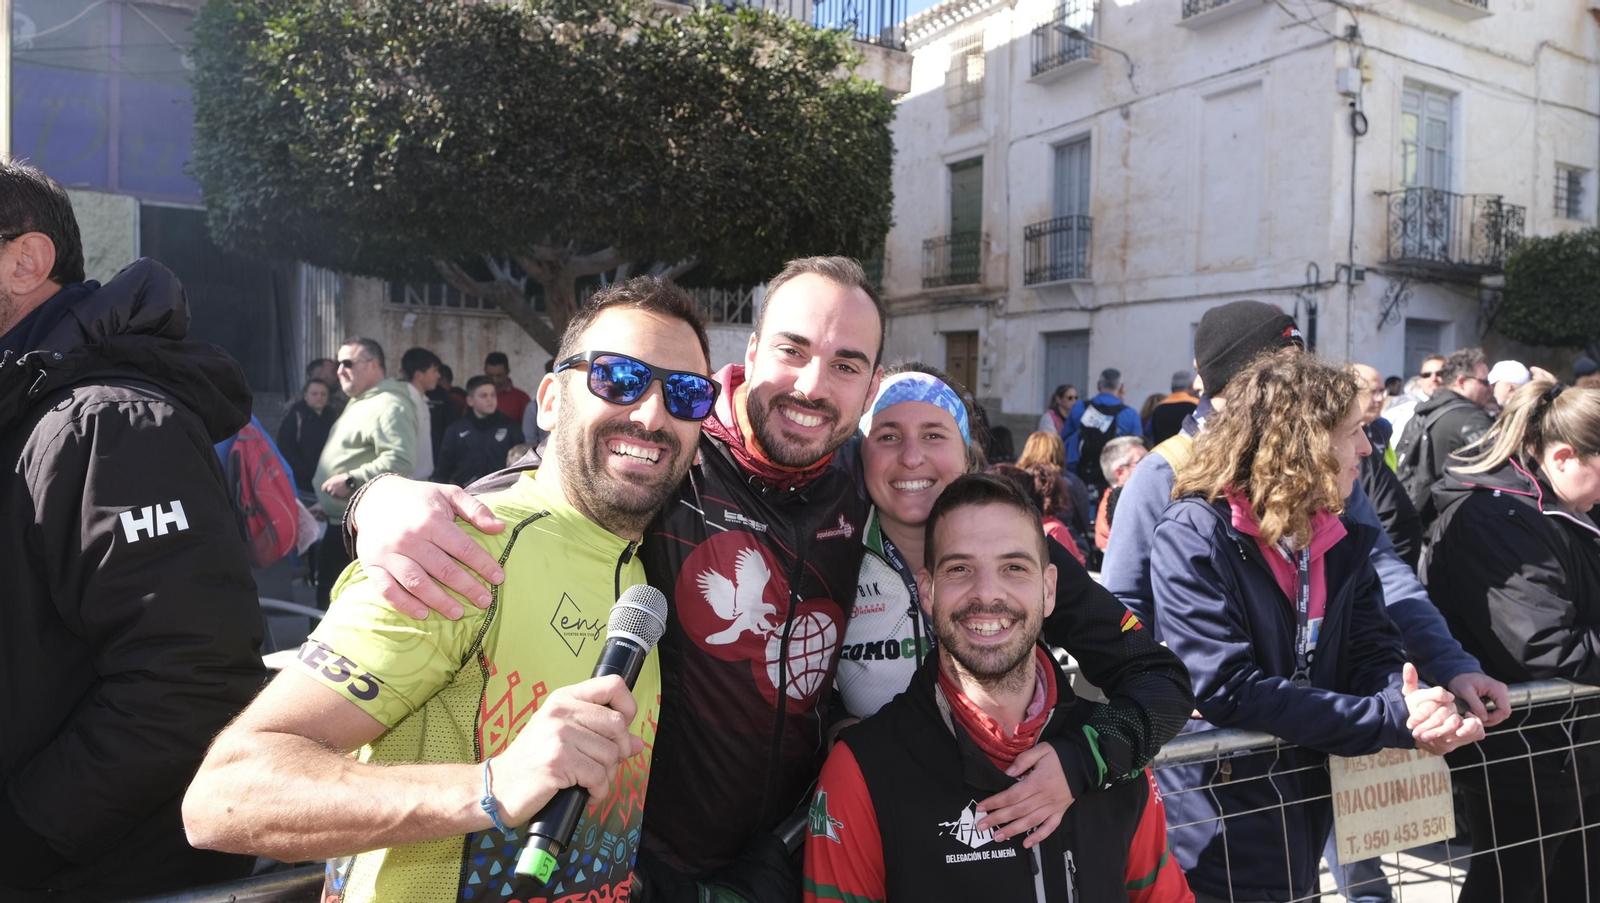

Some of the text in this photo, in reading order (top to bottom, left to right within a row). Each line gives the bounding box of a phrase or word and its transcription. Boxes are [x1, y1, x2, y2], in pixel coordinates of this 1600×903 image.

[119, 500, 189, 543] HH
[1336, 770, 1450, 817] MAQUINARIA
[1364, 828, 1390, 851] 950
[1394, 822, 1419, 844] 453
[1423, 816, 1447, 837] 550
[538, 857, 553, 877] 5
[946, 846, 1017, 864] DELEGACIÓN DE ALMERÍA
